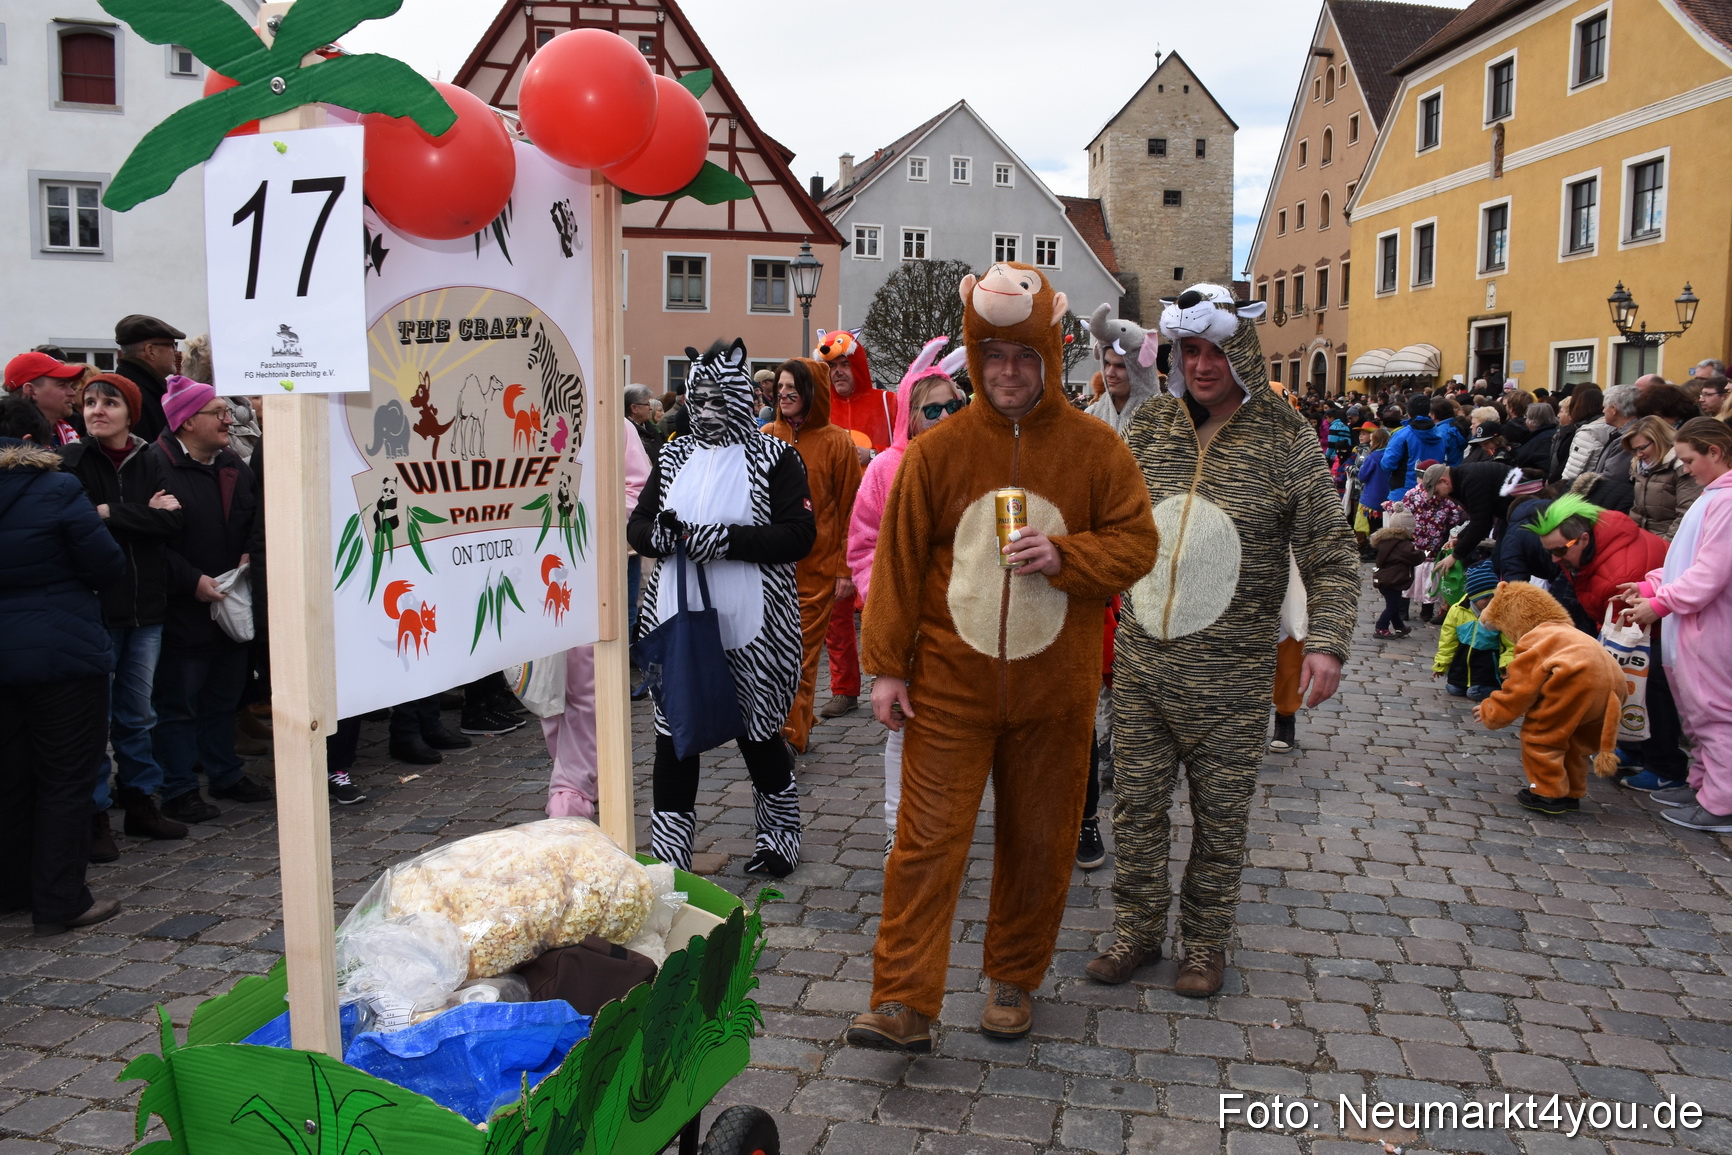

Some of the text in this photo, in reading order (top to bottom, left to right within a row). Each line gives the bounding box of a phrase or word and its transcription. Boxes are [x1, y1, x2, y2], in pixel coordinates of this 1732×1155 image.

[232, 176, 346, 299] 17
[398, 316, 532, 345] THE CRAZY
[260, 361, 317, 369] Faschingsumzug
[1568, 351, 1588, 364] BW
[290, 370, 321, 378] Berching
[394, 455, 562, 495] WILDLIFE
[449, 502, 514, 525] PARK
[452, 539, 514, 565] ON TOUR
